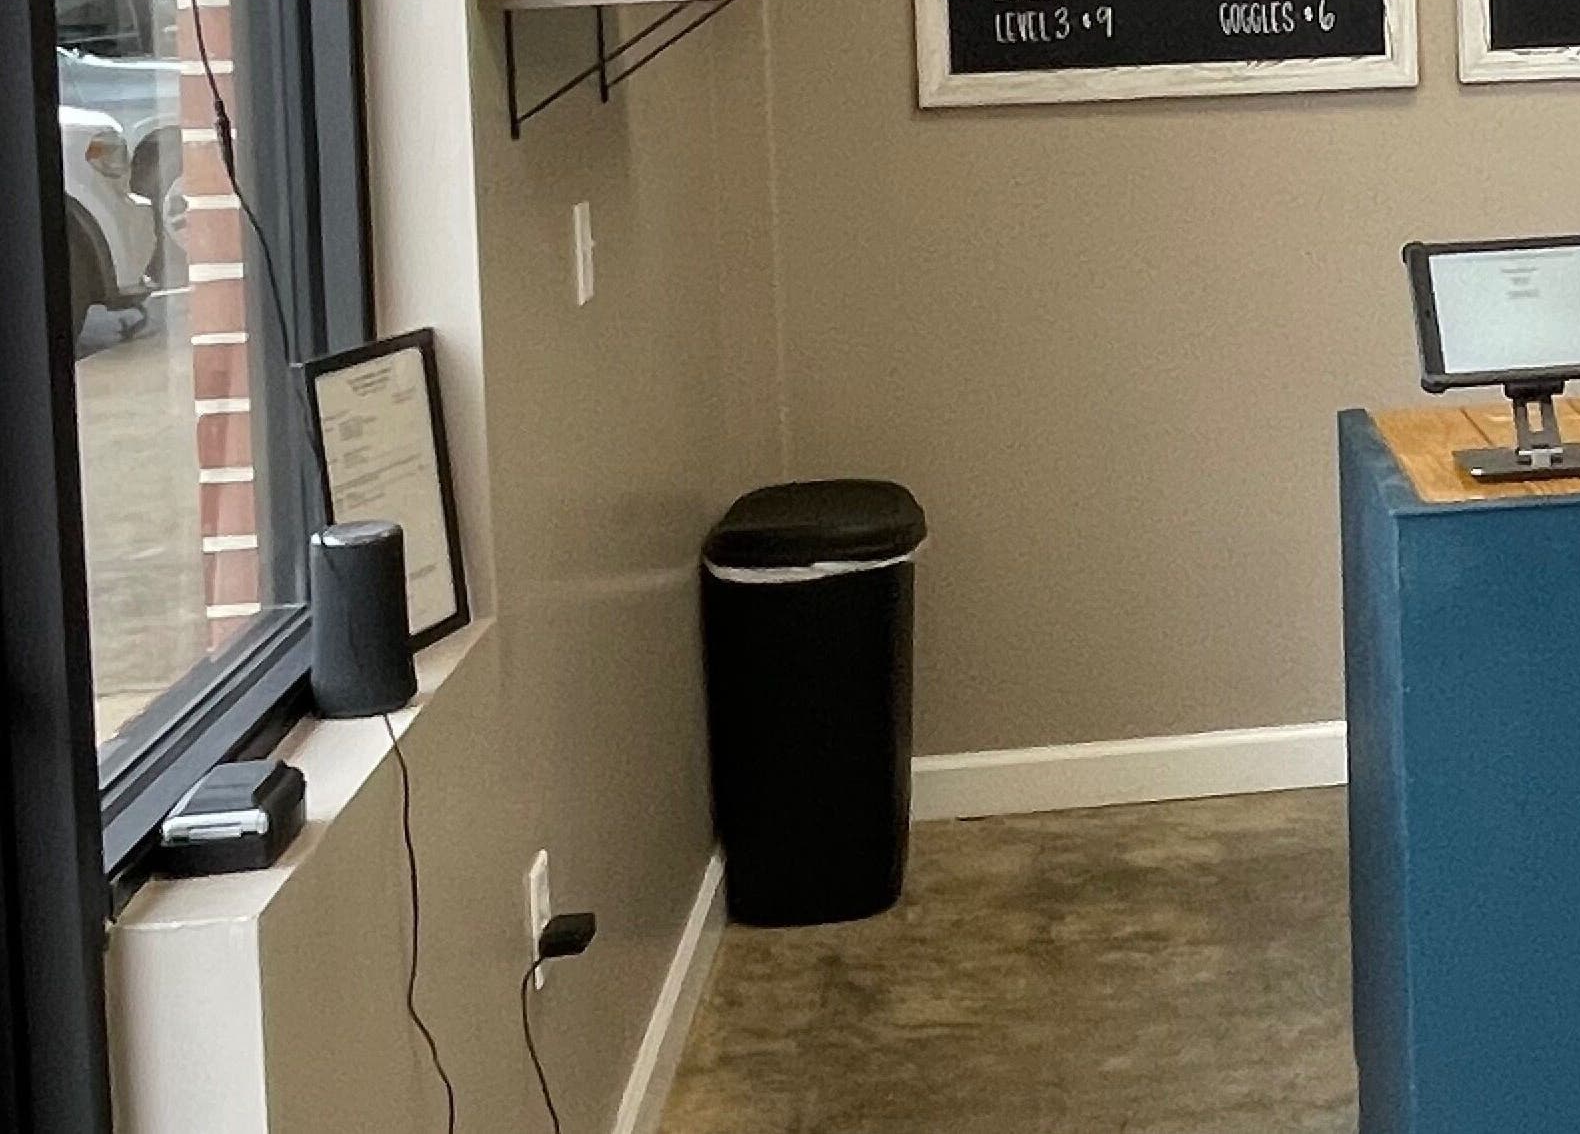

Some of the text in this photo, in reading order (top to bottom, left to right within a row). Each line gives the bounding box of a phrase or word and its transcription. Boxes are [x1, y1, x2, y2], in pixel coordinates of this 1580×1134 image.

[995, 6, 1112, 43] LEVEL 3 $9
[1218, 0, 1295, 36] GOGGLES
